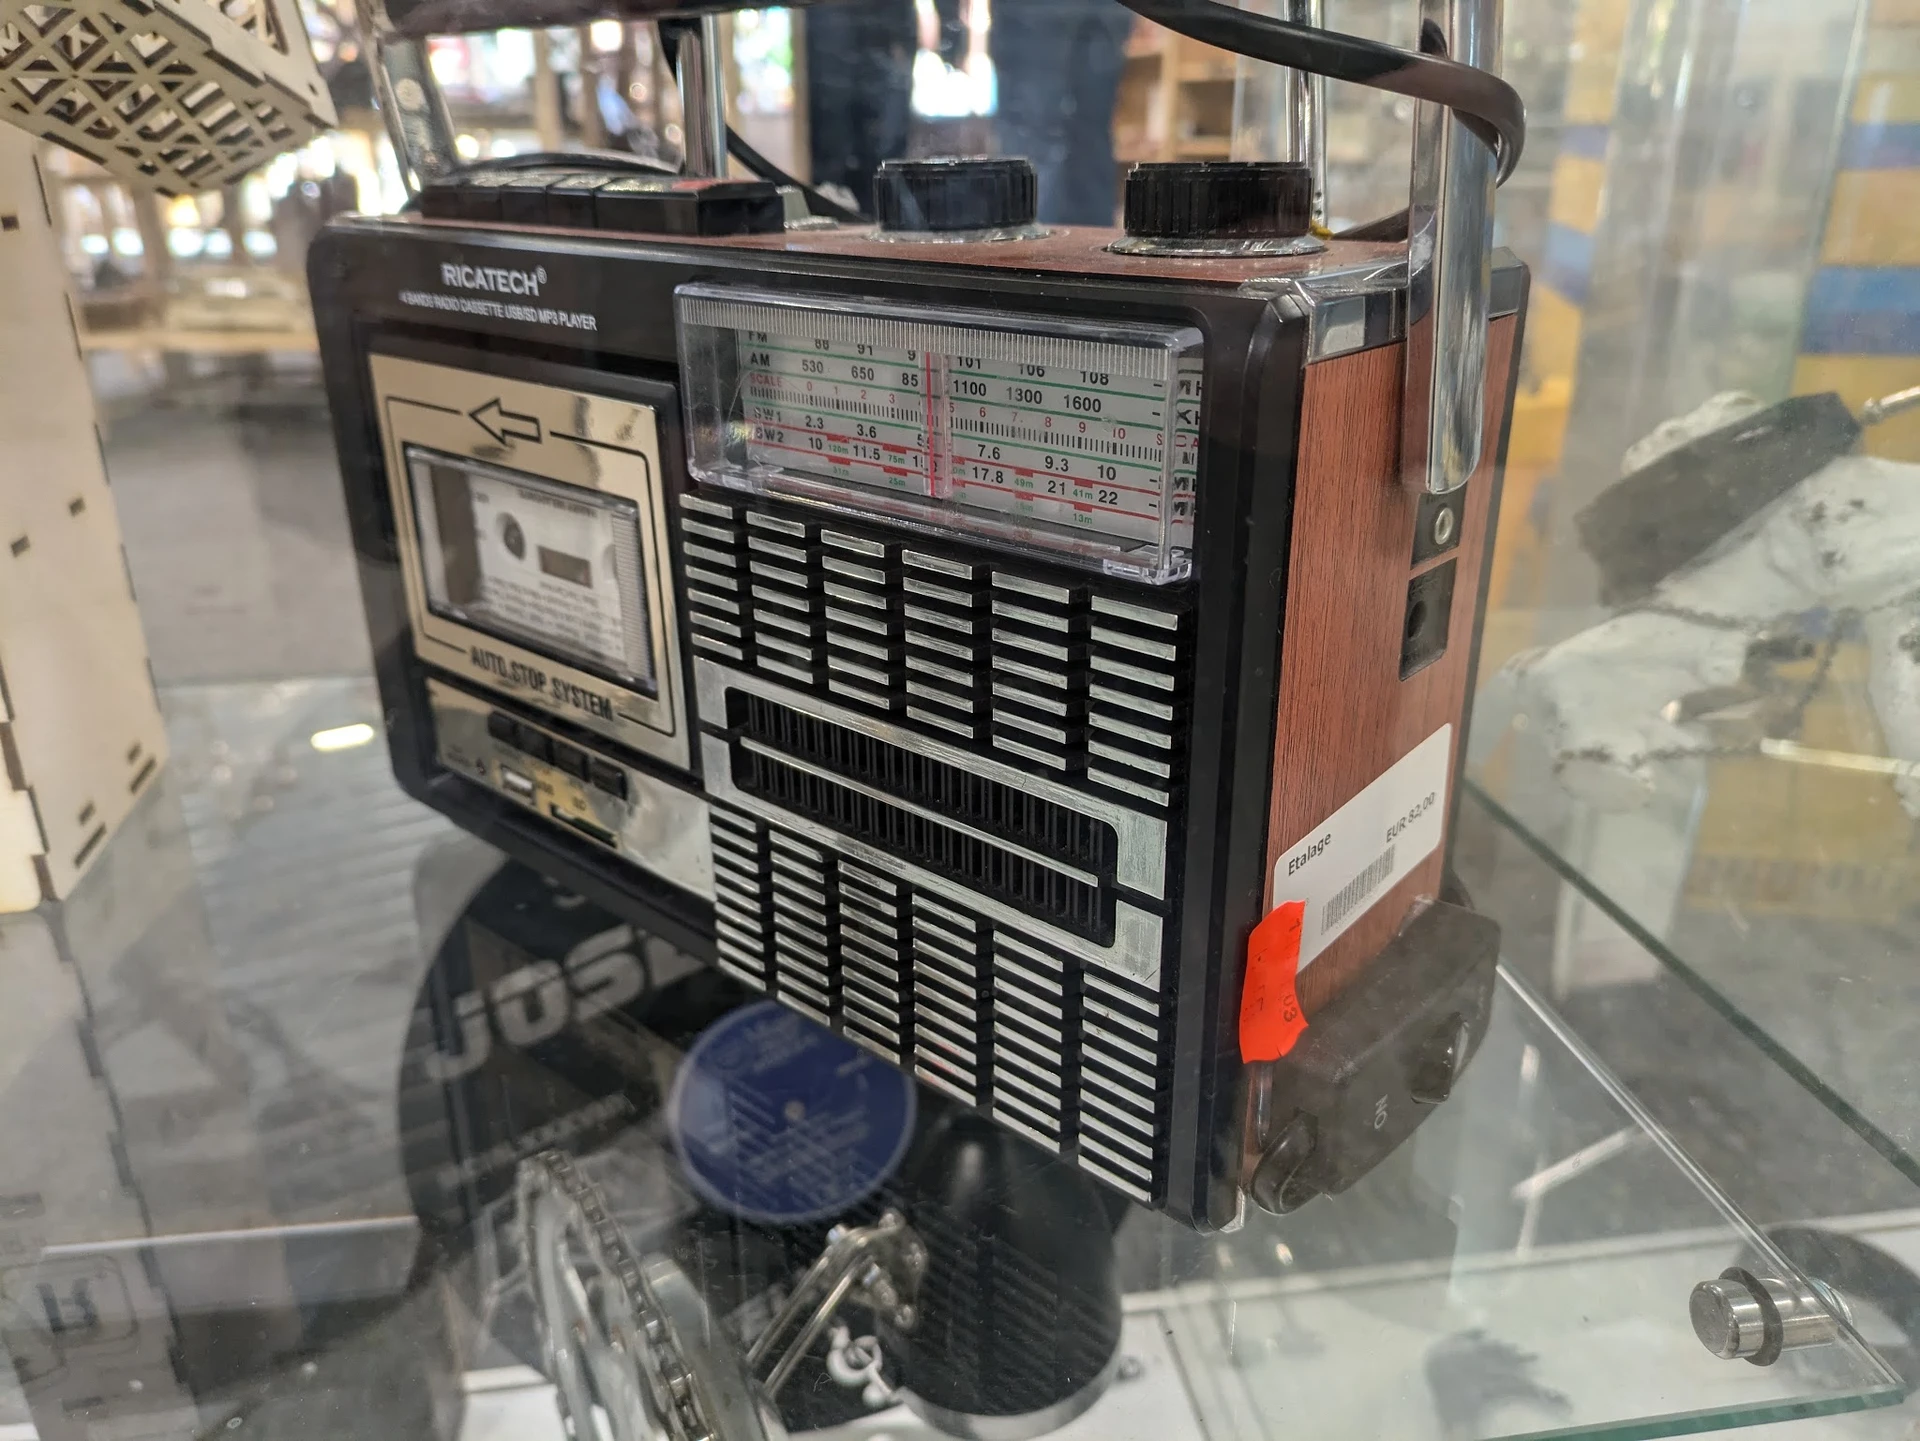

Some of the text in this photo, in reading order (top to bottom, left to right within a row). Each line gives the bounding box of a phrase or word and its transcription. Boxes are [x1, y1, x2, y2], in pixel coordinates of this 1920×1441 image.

[434, 294, 459, 312] RADIO
[460, 297, 504, 318] CASSETTE
[505, 303, 537, 323] USB/SD
[538, 308, 558, 326] MP3
[559, 312, 598, 331] PLAYER
[750, 352, 770, 367] AM
[802, 359, 823, 374] 530
[851, 365, 875, 381] 650
[953, 379, 987, 396] 1100
[1006, 386, 1043, 404] 1300
[1063, 394, 1102, 413] 1600
[806, 380, 813, 392] 0
[860, 389, 867, 400] 2
[889, 393, 896, 404] 3
[979, 406, 987, 418] 6
[1045, 416, 1052, 428] 8
[1078, 421, 1086, 433] 9
[1112, 427, 1126, 440] 10
[755, 427, 1118, 506] SW2 10 11.5 17.8 21 22
[805, 415, 824, 430] 2.3
[856, 423, 877, 439] 3.6
[977, 444, 1001, 460] 7.6
[1045, 455, 1069, 472] 9.3
[1097, 464, 1117, 481] 10
[888, 454, 905, 465] 75m
[1014, 478, 1034, 489] 49m
[1072, 488, 1093, 500] 41m
[888, 476, 906, 487] 25m
[1072, 513, 1093, 525] 13m
[552, 677, 614, 722] SYSTEM
[1288, 833, 1332, 876] Etalage
[1386, 816, 1407, 843] EUR
[1374, 1093, 1388, 1129] ON
